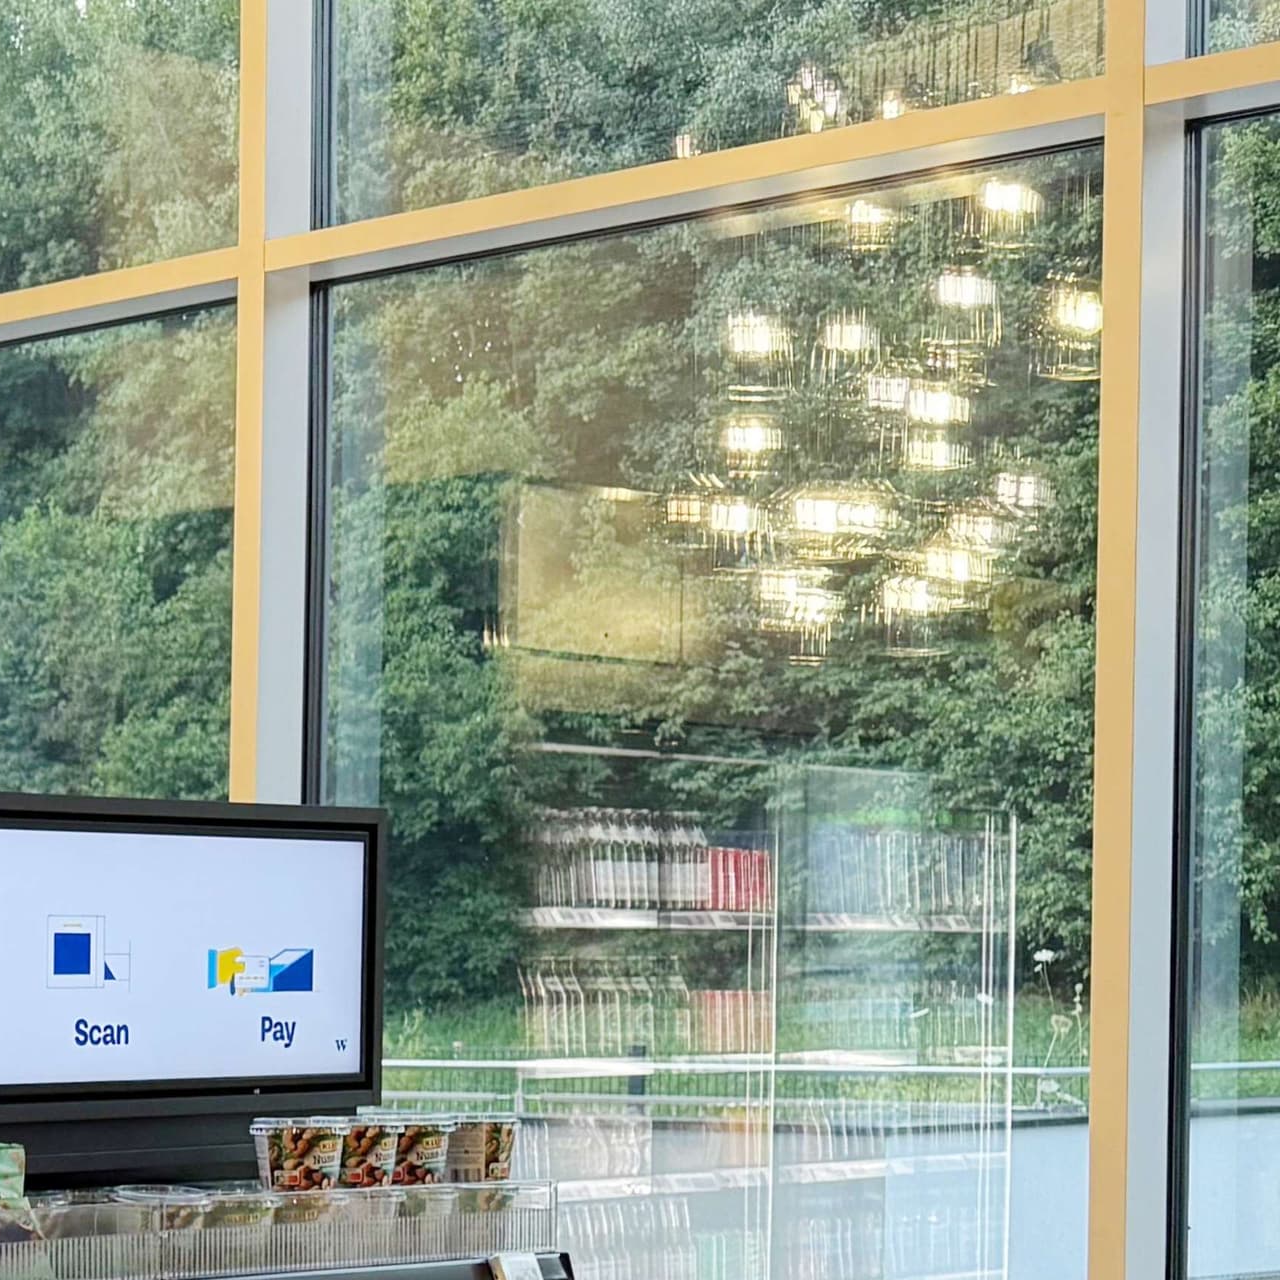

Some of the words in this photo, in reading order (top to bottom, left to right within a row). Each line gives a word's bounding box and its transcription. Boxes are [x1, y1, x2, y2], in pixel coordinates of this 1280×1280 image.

[73, 1018, 130, 1047] Scan
[260, 1015, 297, 1049] Pay
[334, 1038, 348, 1053] W
